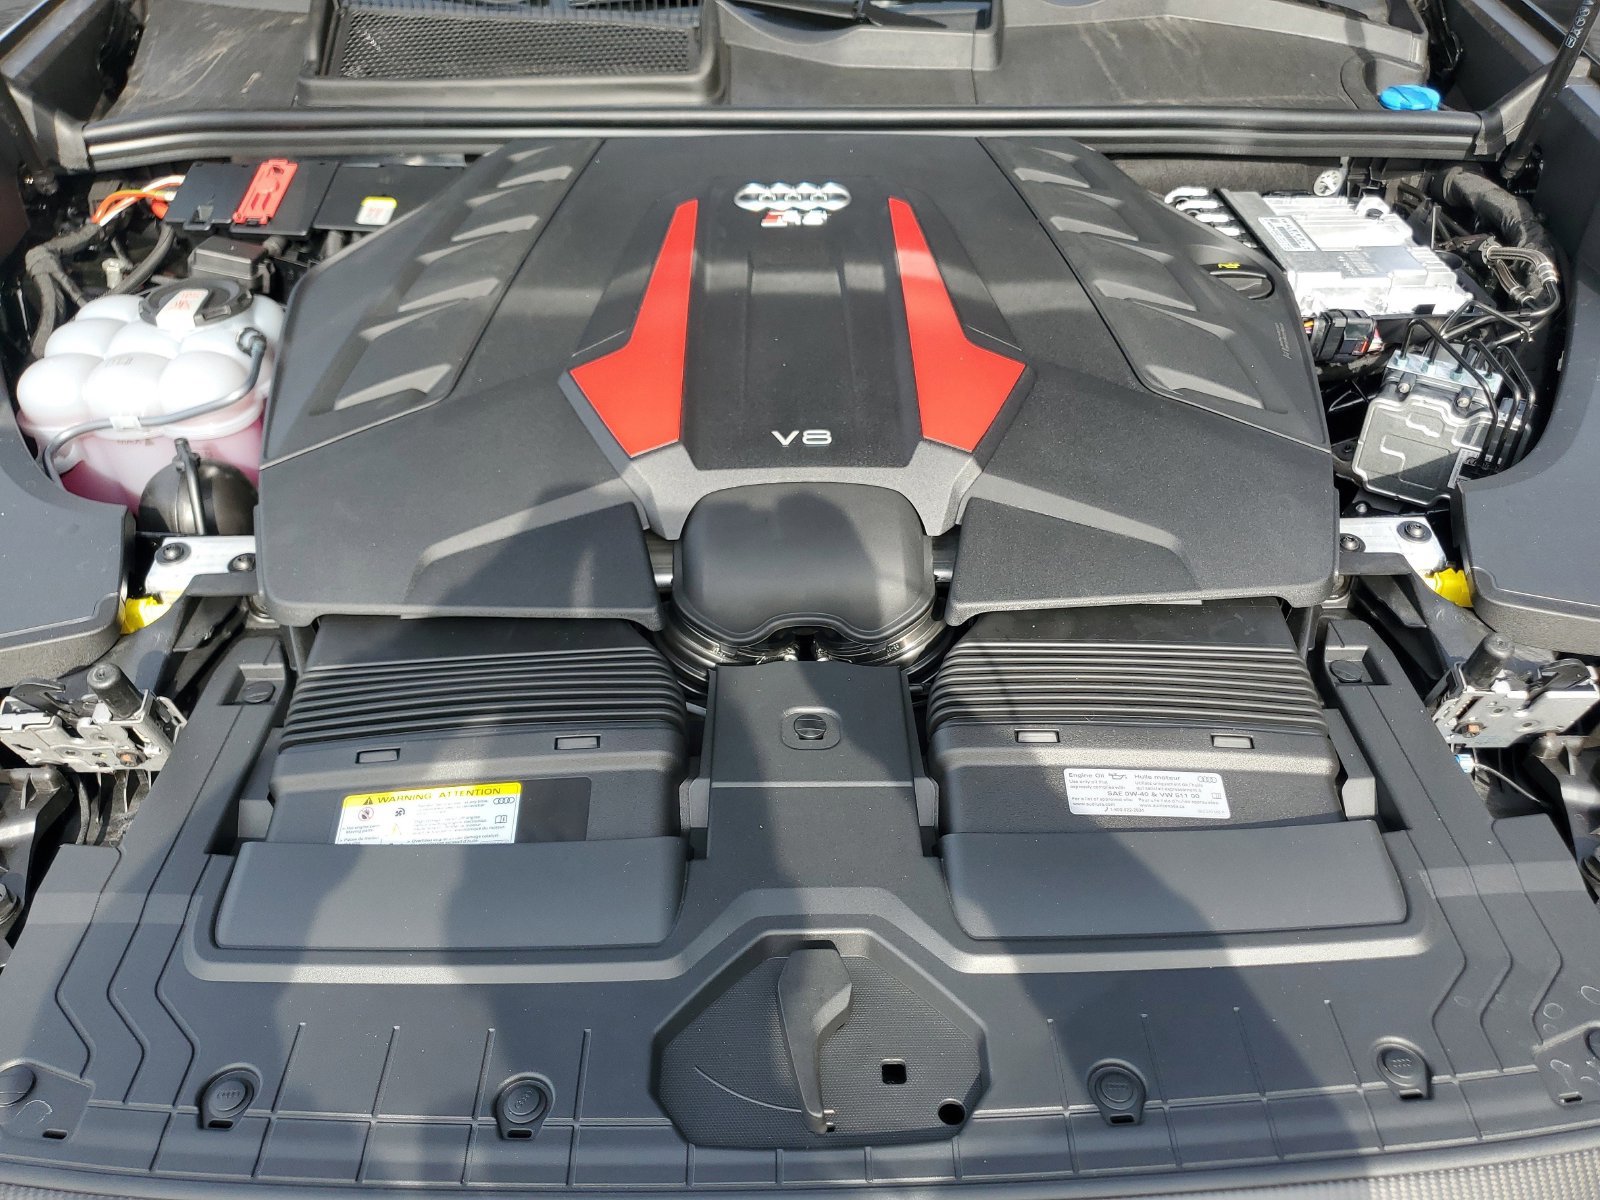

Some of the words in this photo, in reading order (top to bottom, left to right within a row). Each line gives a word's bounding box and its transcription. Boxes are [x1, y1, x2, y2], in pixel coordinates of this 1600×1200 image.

[771, 430, 832, 446] V8
[378, 792, 432, 804] WARNING
[439, 788, 501, 799] ATTENTION
